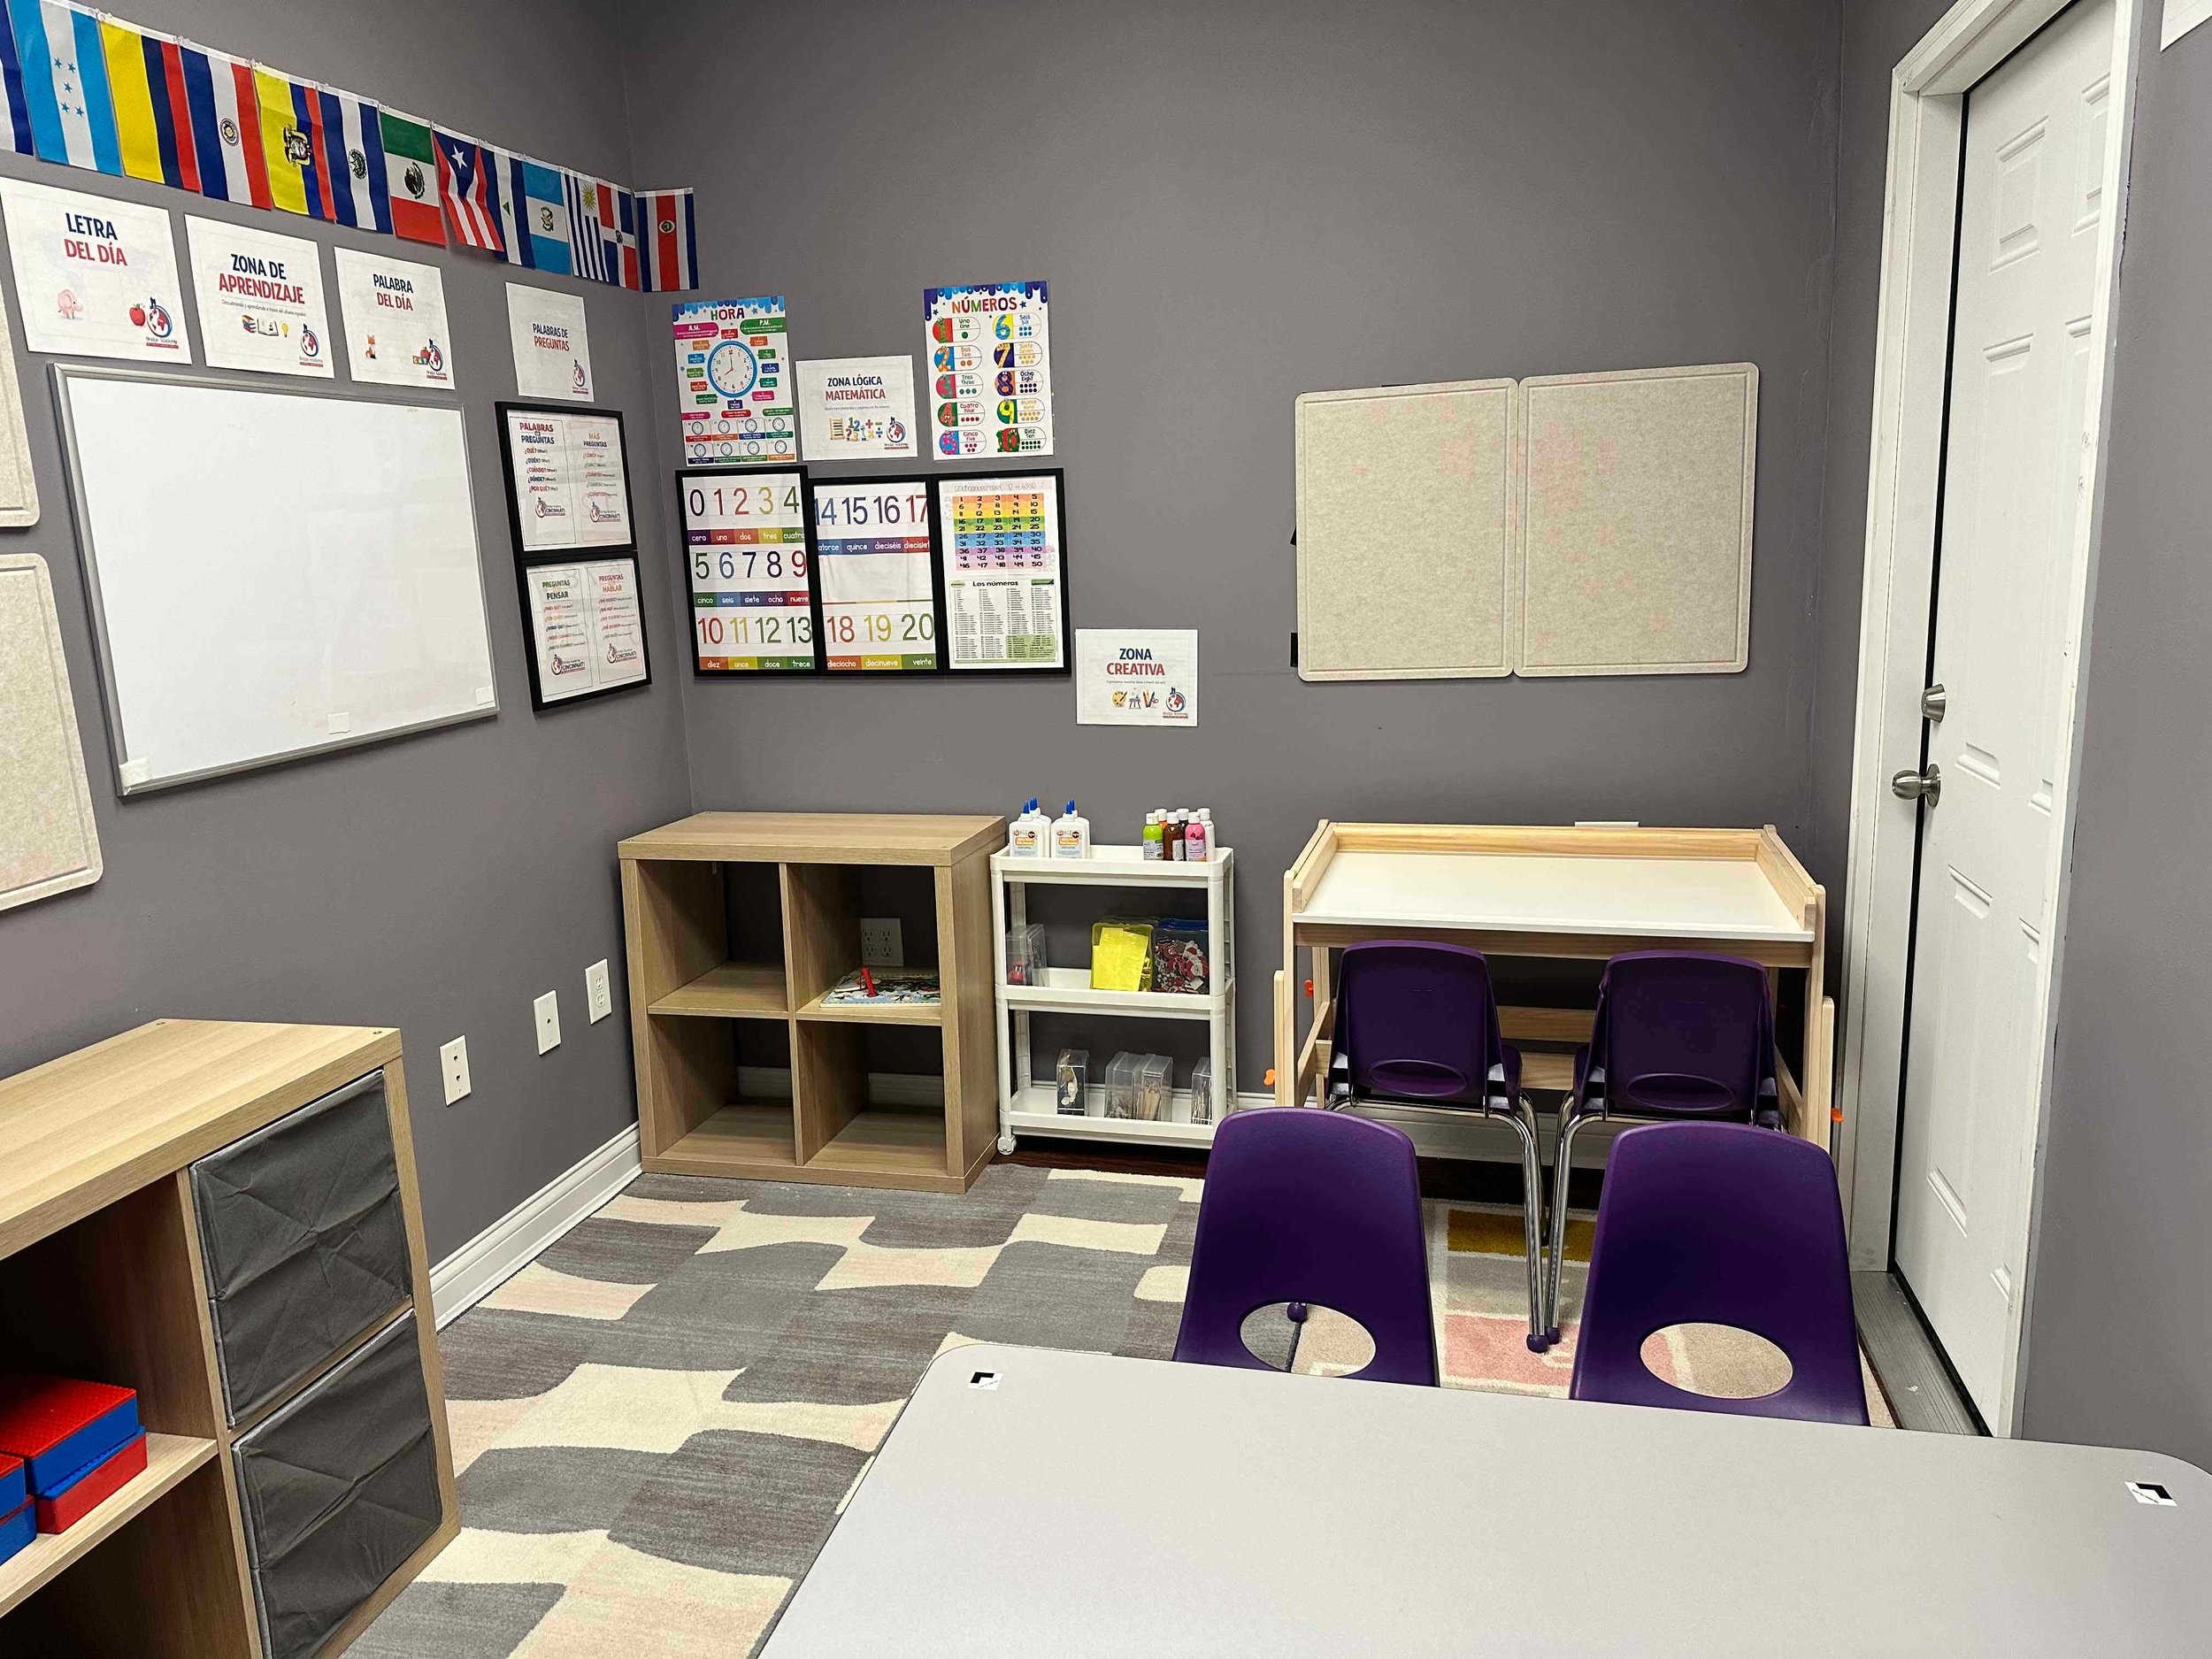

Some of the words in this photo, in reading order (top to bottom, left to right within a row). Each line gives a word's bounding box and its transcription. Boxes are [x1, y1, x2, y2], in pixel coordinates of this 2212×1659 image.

[65, 212, 118, 240] LETRA
[65, 239, 95, 261] DEL
[97, 242, 127, 265] DÍA
[231, 254, 266, 276] ZONA
[269, 261, 287, 280] DE
[219, 273, 304, 304] APRENDIZAJE
[373, 273, 413, 294] PALABRA
[377, 292, 394, 307] DEL
[396, 294, 413, 311] DÍA
[952, 296, 1017, 313] NÚMEROS
[710, 308, 744, 320] HORA
[533, 323, 561, 336] PALABRAS
[562, 329, 568, 338] DE
[995, 314, 1010, 340] 6
[534, 336, 569, 351] PREGUNTAS
[937, 346, 951, 372] 2
[996, 343, 1010, 368] 7
[827, 377, 850, 387] ZONA
[853, 374, 882, 386] LÓGICA
[996, 371, 1013, 396] 8
[826, 387, 886, 401] MATEMÁTICA
[940, 403, 955, 426] 4
[1000, 399, 1014, 424] 9
[519, 422, 553, 432] PALABRAS
[854, 420, 860, 431] 2
[521, 435, 554, 444] PREGUNTAS
[941, 432, 956, 455] 5
[690, 489, 704, 516] 0
[714, 488, 723, 515] 1
[733, 488, 749, 515] 2
[758, 487, 773, 515] 3
[784, 487, 799, 513] 4
[841, 497, 867, 525] 15
[873, 495, 901, 524] 16
[906, 495, 927, 522] 17
[695, 552, 710, 580] 5
[719, 551, 734, 579] 6
[742, 552, 757, 579] 7
[767, 550, 782, 579] 8
[791, 549, 807, 578] 9
[547, 591, 568, 600] PENSAR
[698, 618, 723, 644] 10
[730, 618, 749, 643] 11
[756, 617, 781, 643] 12
[787, 617, 812, 643] 13
[827, 616, 855, 642] 18
[864, 615, 891, 641] 19
[902, 613, 934, 641] 20
[1119, 649, 1152, 660] ZONA
[1107, 663, 1165, 675] CREATIVA
